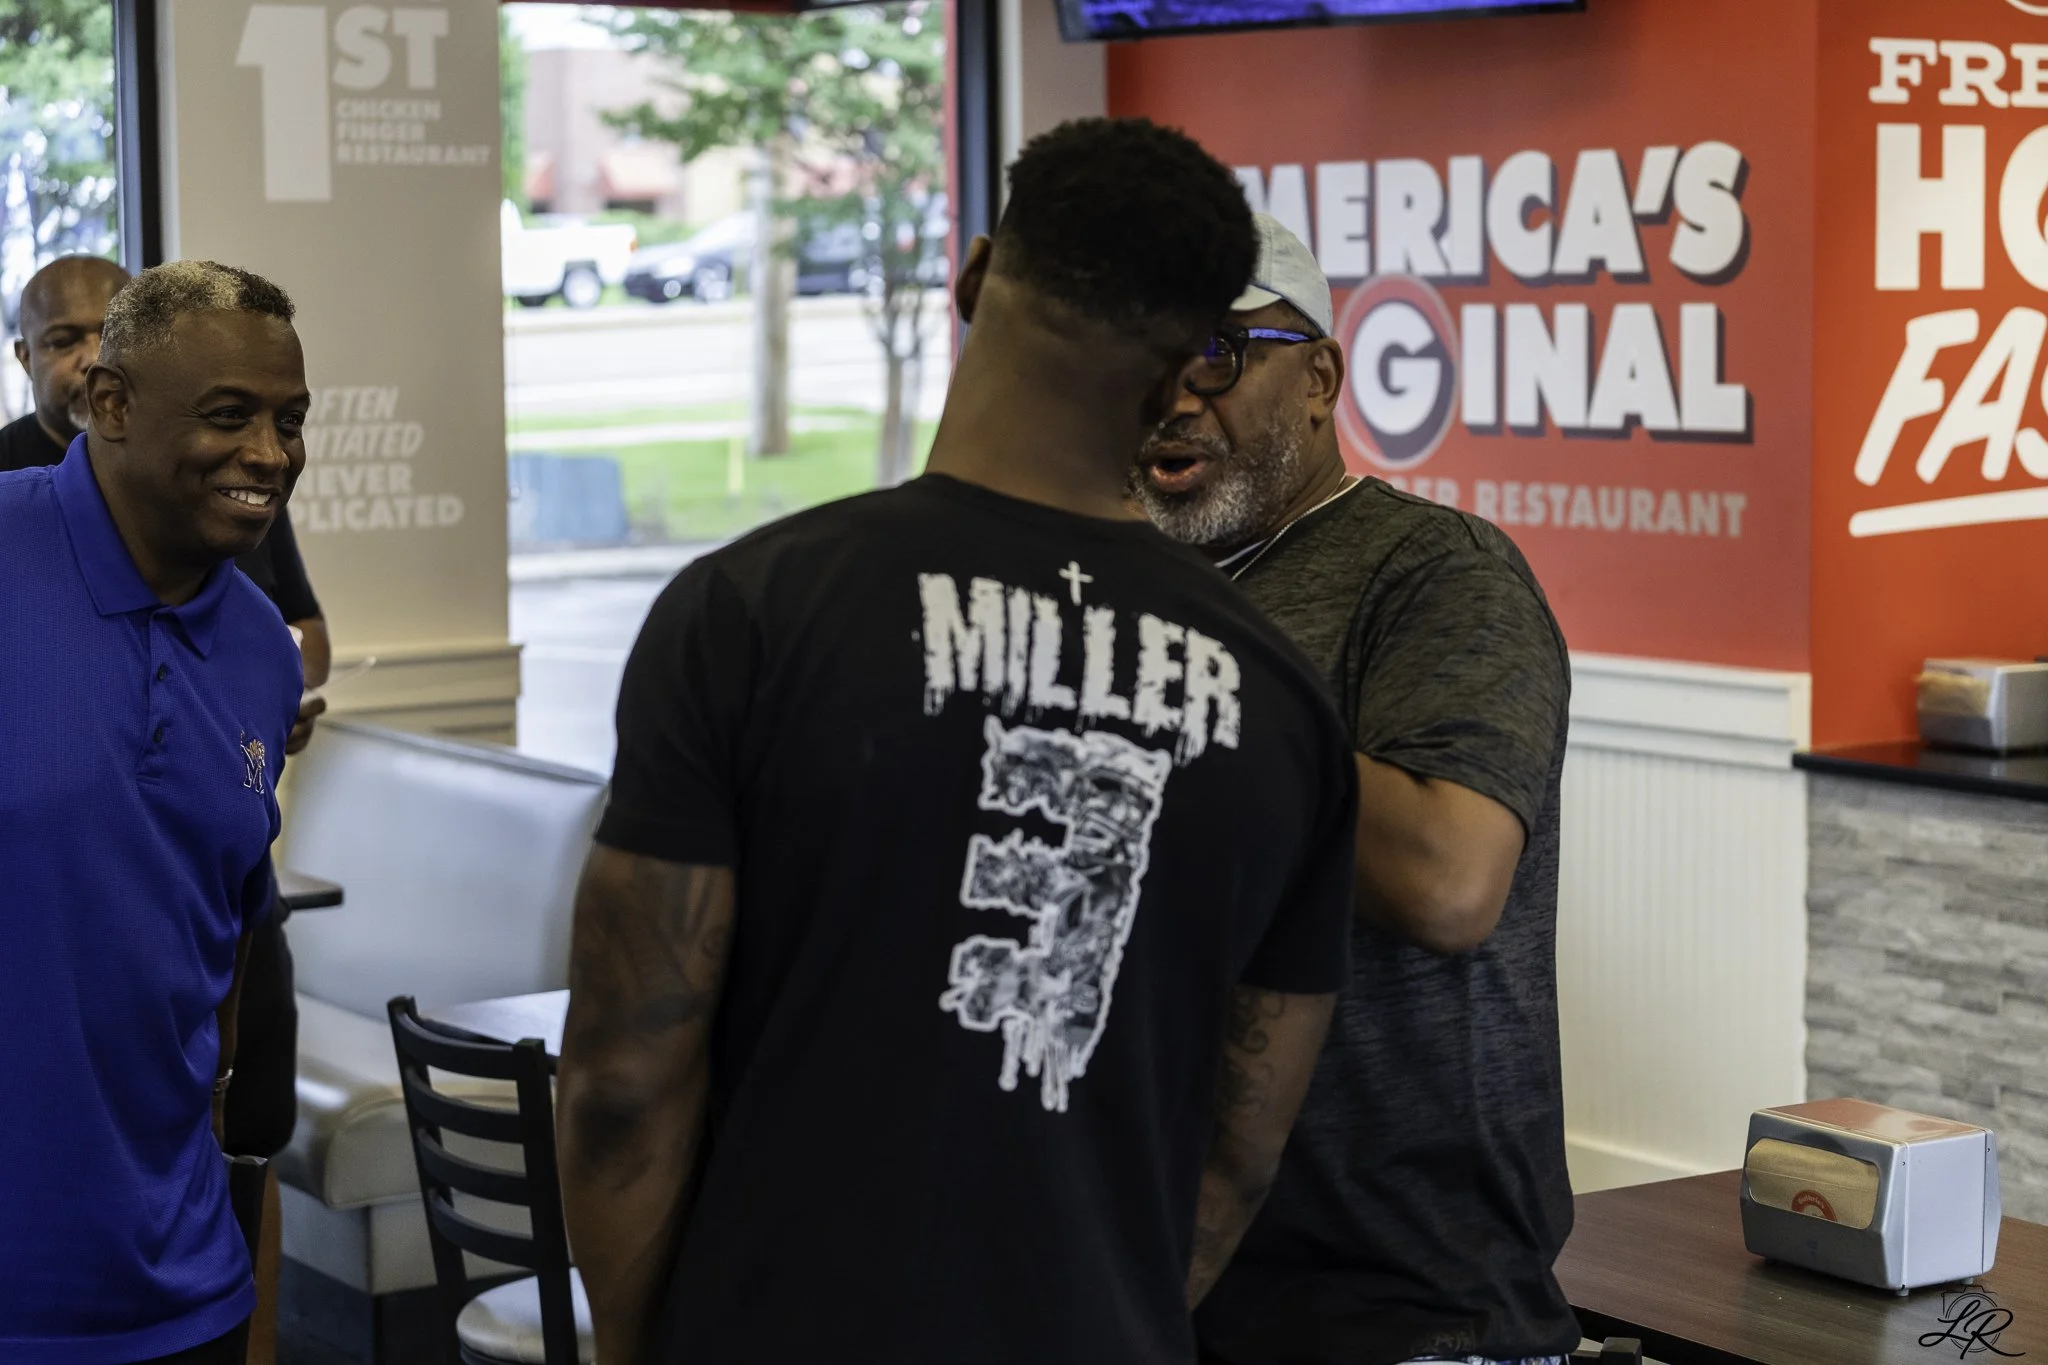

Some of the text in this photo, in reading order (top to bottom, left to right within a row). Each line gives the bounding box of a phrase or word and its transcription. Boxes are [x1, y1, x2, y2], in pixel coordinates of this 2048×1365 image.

[336, 100, 441, 120] CHICKEN
[336, 122, 426, 142] FINGER
[336, 145, 490, 165] RESTAURANT
[1234, 141, 1748, 282] MERICA'S
[1351, 301, 1749, 438] GINAL
[289, 493, 465, 532] PLICATED
[1475, 480, 1745, 537] RESTAURANT
[918, 573, 1241, 764] MILLER
[940, 714, 1172, 1112] 3
